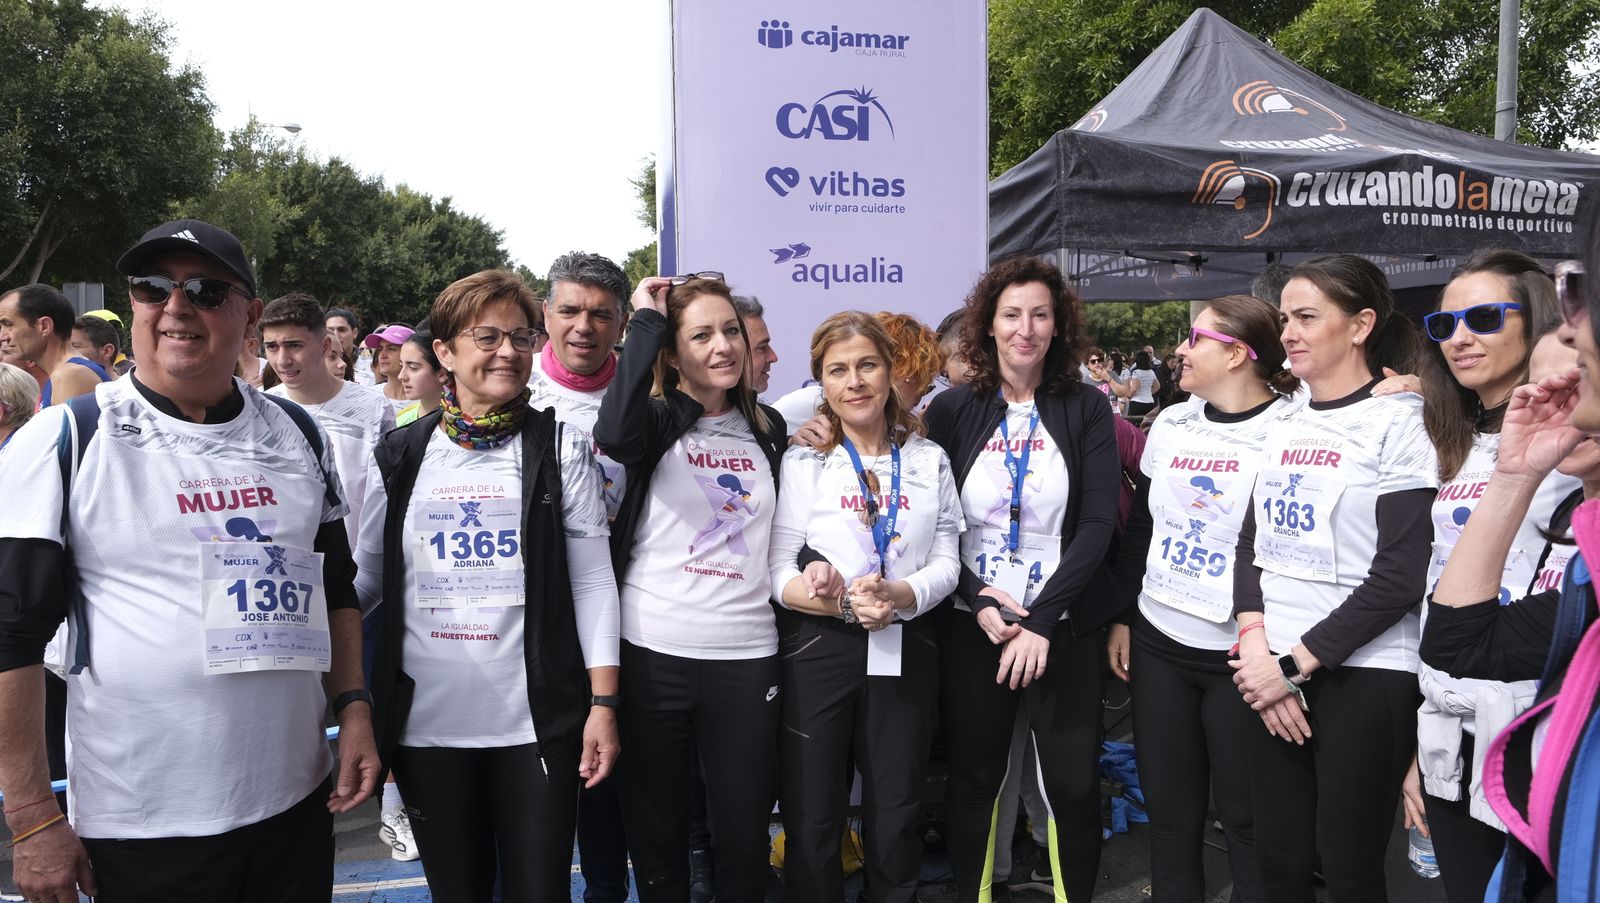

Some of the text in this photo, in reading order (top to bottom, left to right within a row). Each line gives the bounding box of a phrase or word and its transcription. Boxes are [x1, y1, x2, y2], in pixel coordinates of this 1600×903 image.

[801, 25, 910, 52] cajamar
[855, 49, 908, 58] CAJA RURAL
[775, 102, 870, 141] CASI
[809, 171, 905, 197] vithas
[809, 202, 905, 214] vivir para cuidarte
[1383, 211, 1573, 234] cronometraje deportivo
[791, 257, 903, 289] aqualia
[688, 443, 724, 456] CAERA
[1179, 448, 1213, 458] CARRERA
[687, 452, 756, 472] MUJER
[1169, 456, 1240, 473] MUJER
[1280, 449, 1342, 468] MUJER
[179, 473, 267, 489] CARRERA DE LA
[431, 484, 505, 496] CARRERA DE LA
[890, 488, 898, 505] NEXA
[1435, 481, 1489, 502] MUJE
[176, 486, 278, 514] MUJER
[429, 513, 455, 521] MUJER
[1263, 497, 1316, 532] 1363
[886, 518, 894, 536] NEXA
[1274, 526, 1300, 538] ARANCHA
[430, 529, 519, 560] 1365
[223, 558, 259, 567] MUJER
[453, 559, 495, 568] ADRIANA
[1161, 535, 1227, 578] 1359
[684, 565, 693, 573] ES
[694, 567, 726, 578] NUESTRA
[705, 561, 738, 571] IGUALDAD
[975, 552, 1043, 584] 14
[1169, 563, 1201, 579] CARMEN
[227, 579, 313, 614] 1367
[242, 613, 309, 624] JOSE ANTONIO
[441, 622, 489, 631] LA IGUALDAD
[235, 632, 253, 641] CDX
[431, 631, 439, 639] ES
[440, 632, 475, 641] NUESTRA
